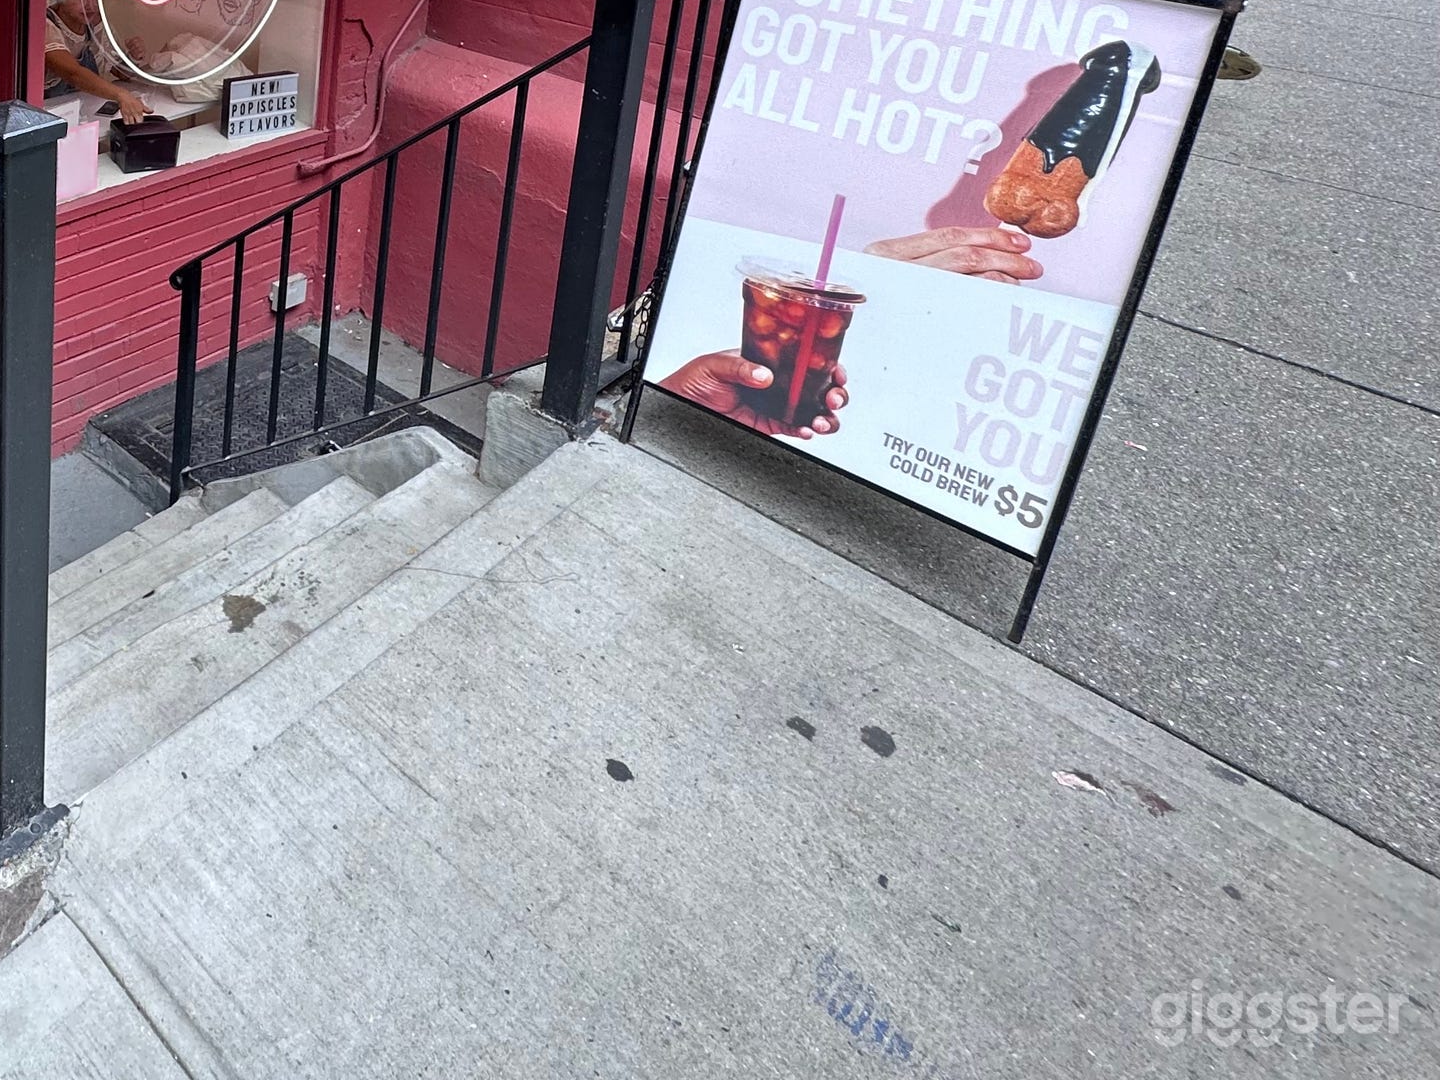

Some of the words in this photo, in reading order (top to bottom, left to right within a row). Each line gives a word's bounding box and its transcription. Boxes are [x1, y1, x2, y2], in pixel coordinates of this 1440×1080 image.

[251, 80, 280, 97] NEW!
[740, 6, 855, 74] GOT
[866, 28, 991, 105] YOU
[231, 96, 296, 118] POPISCLES
[238, 113, 296, 134] FLAVORS
[722, 63, 821, 133] ALL
[832, 87, 1004, 176] HOT?
[1008, 304, 1105, 381] WE
[964, 354, 1089, 433] GOT
[882, 432, 915, 456] TRY
[915, 446, 951, 474] OUR
[953, 462, 995, 491] NEW
[953, 401, 1068, 486] YOU
[889, 453, 934, 483] COLD
[935, 475, 989, 508] BREW
[994, 484, 1049, 529] $5
